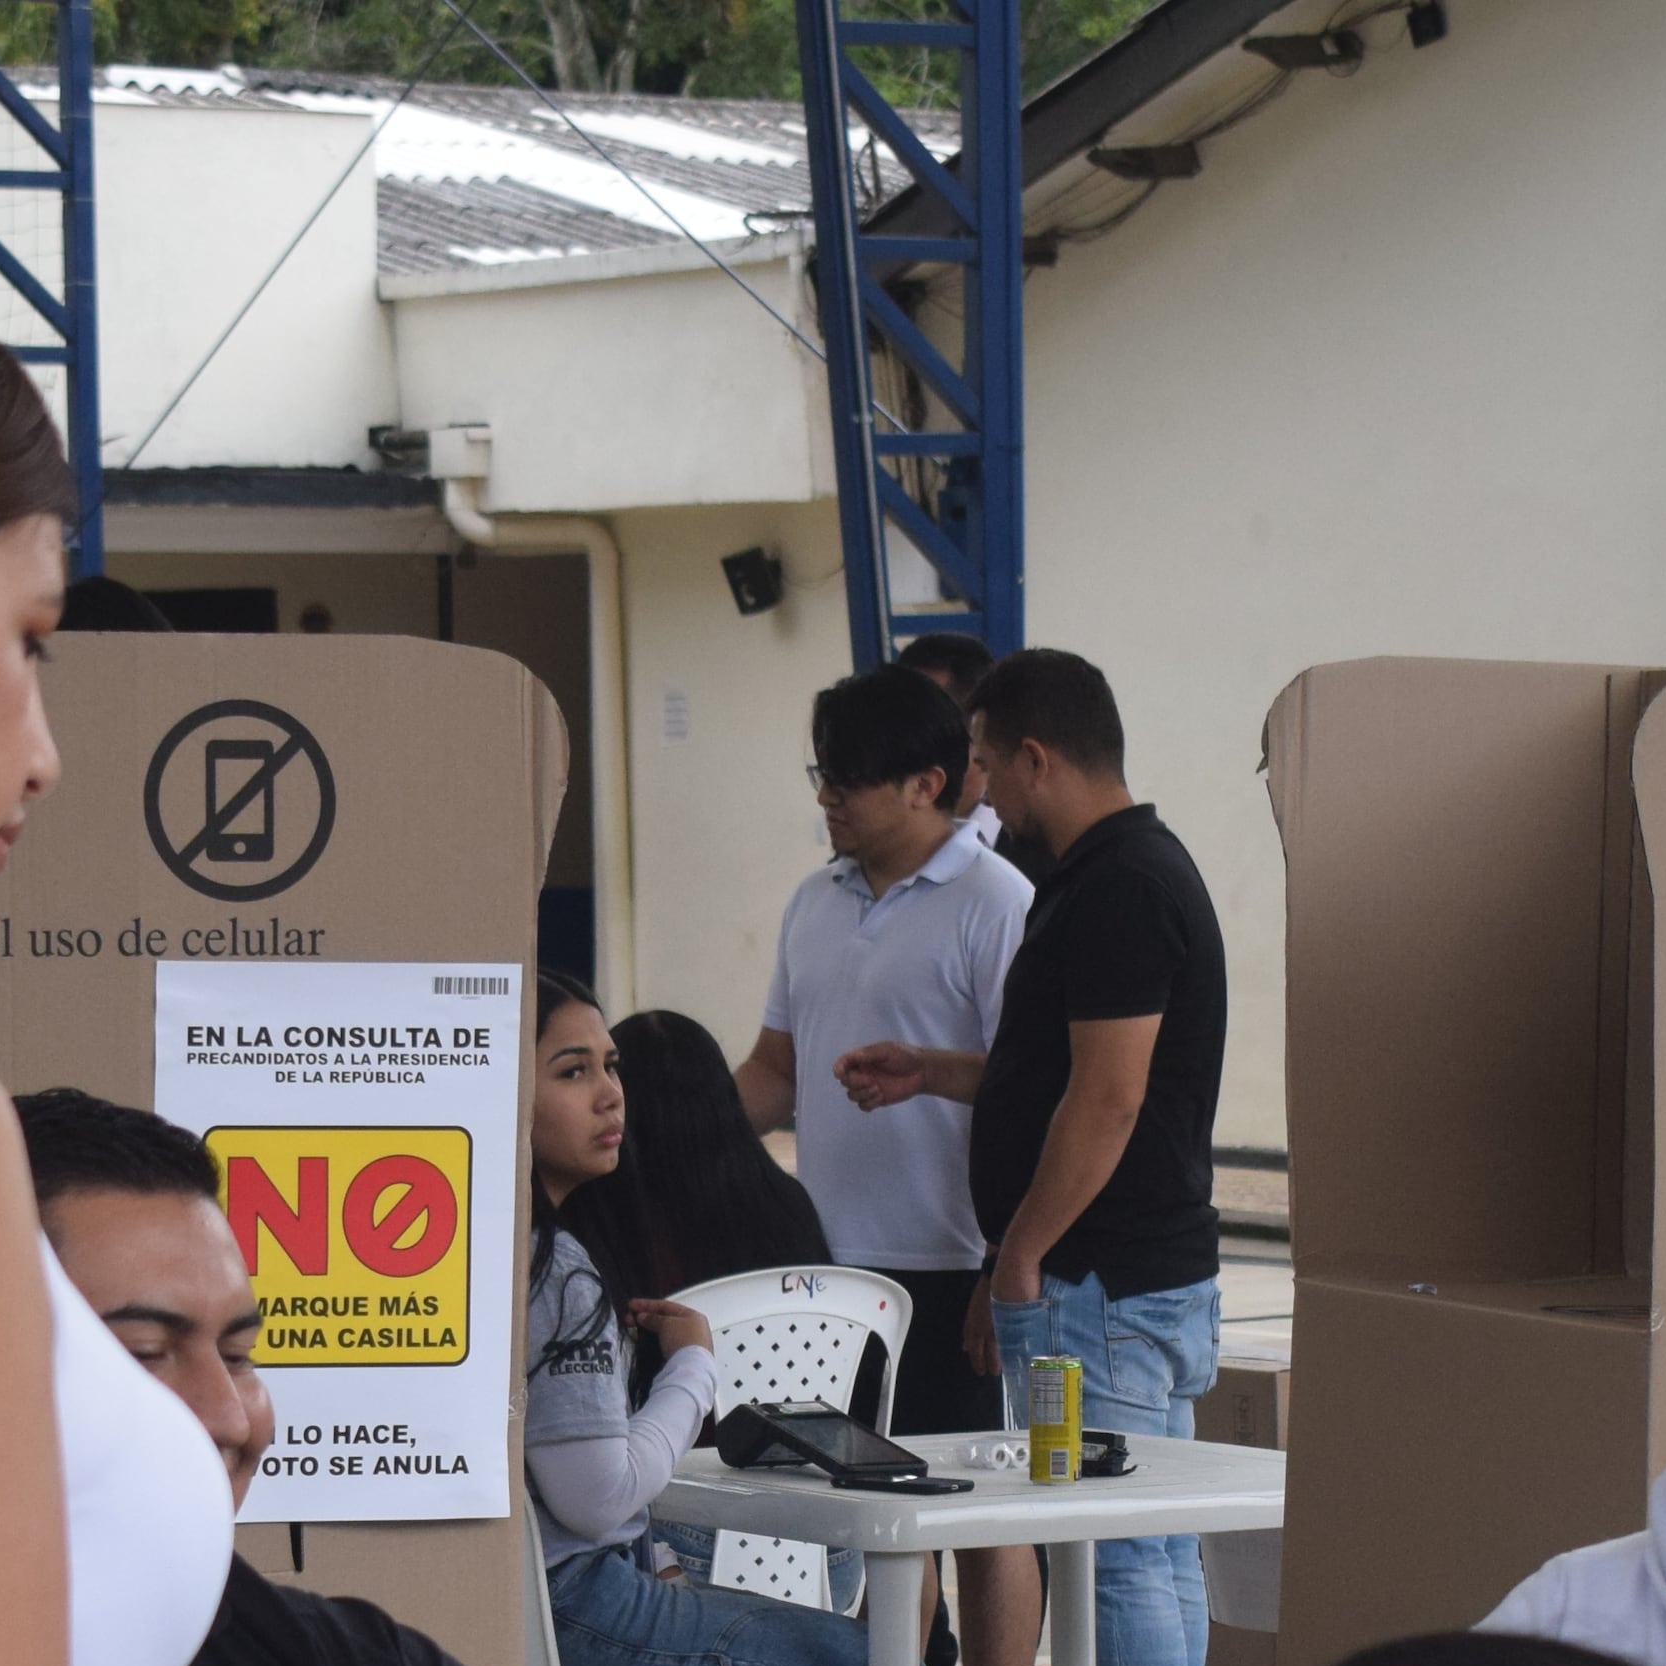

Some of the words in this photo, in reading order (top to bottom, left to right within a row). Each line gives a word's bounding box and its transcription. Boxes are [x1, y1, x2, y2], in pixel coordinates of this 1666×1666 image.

[29, 926, 102, 957] uso
[118, 918, 167, 957] de
[181, 918, 326, 957] celular
[187, 1026, 225, 1046] EN
[236, 1026, 273, 1047] LA
[283, 1026, 443, 1048] CONSULTA
[453, 1028, 491, 1048] DE
[187, 1053, 328, 1066] PRECANDIDATOS
[334, 1053, 345, 1065] A
[351, 1053, 372, 1065] LA
[377, 1053, 490, 1067] PRESIDENCIA
[275, 1071, 297, 1083] DE
[303, 1071, 323, 1083] LA
[330, 1068, 425, 1084] REPÚBLICA
[226, 1154, 458, 1277] NO
[379, 1292, 439, 1316] MÁS
[267, 1328, 328, 1349] UNA
[337, 1328, 457, 1348] CASILLA
[287, 1425, 322, 1445] LO
[333, 1424, 416, 1448] HACE,
[253, 1456, 319, 1477] OTO
[329, 1456, 364, 1476] SE
[373, 1455, 469, 1475] ANULA
